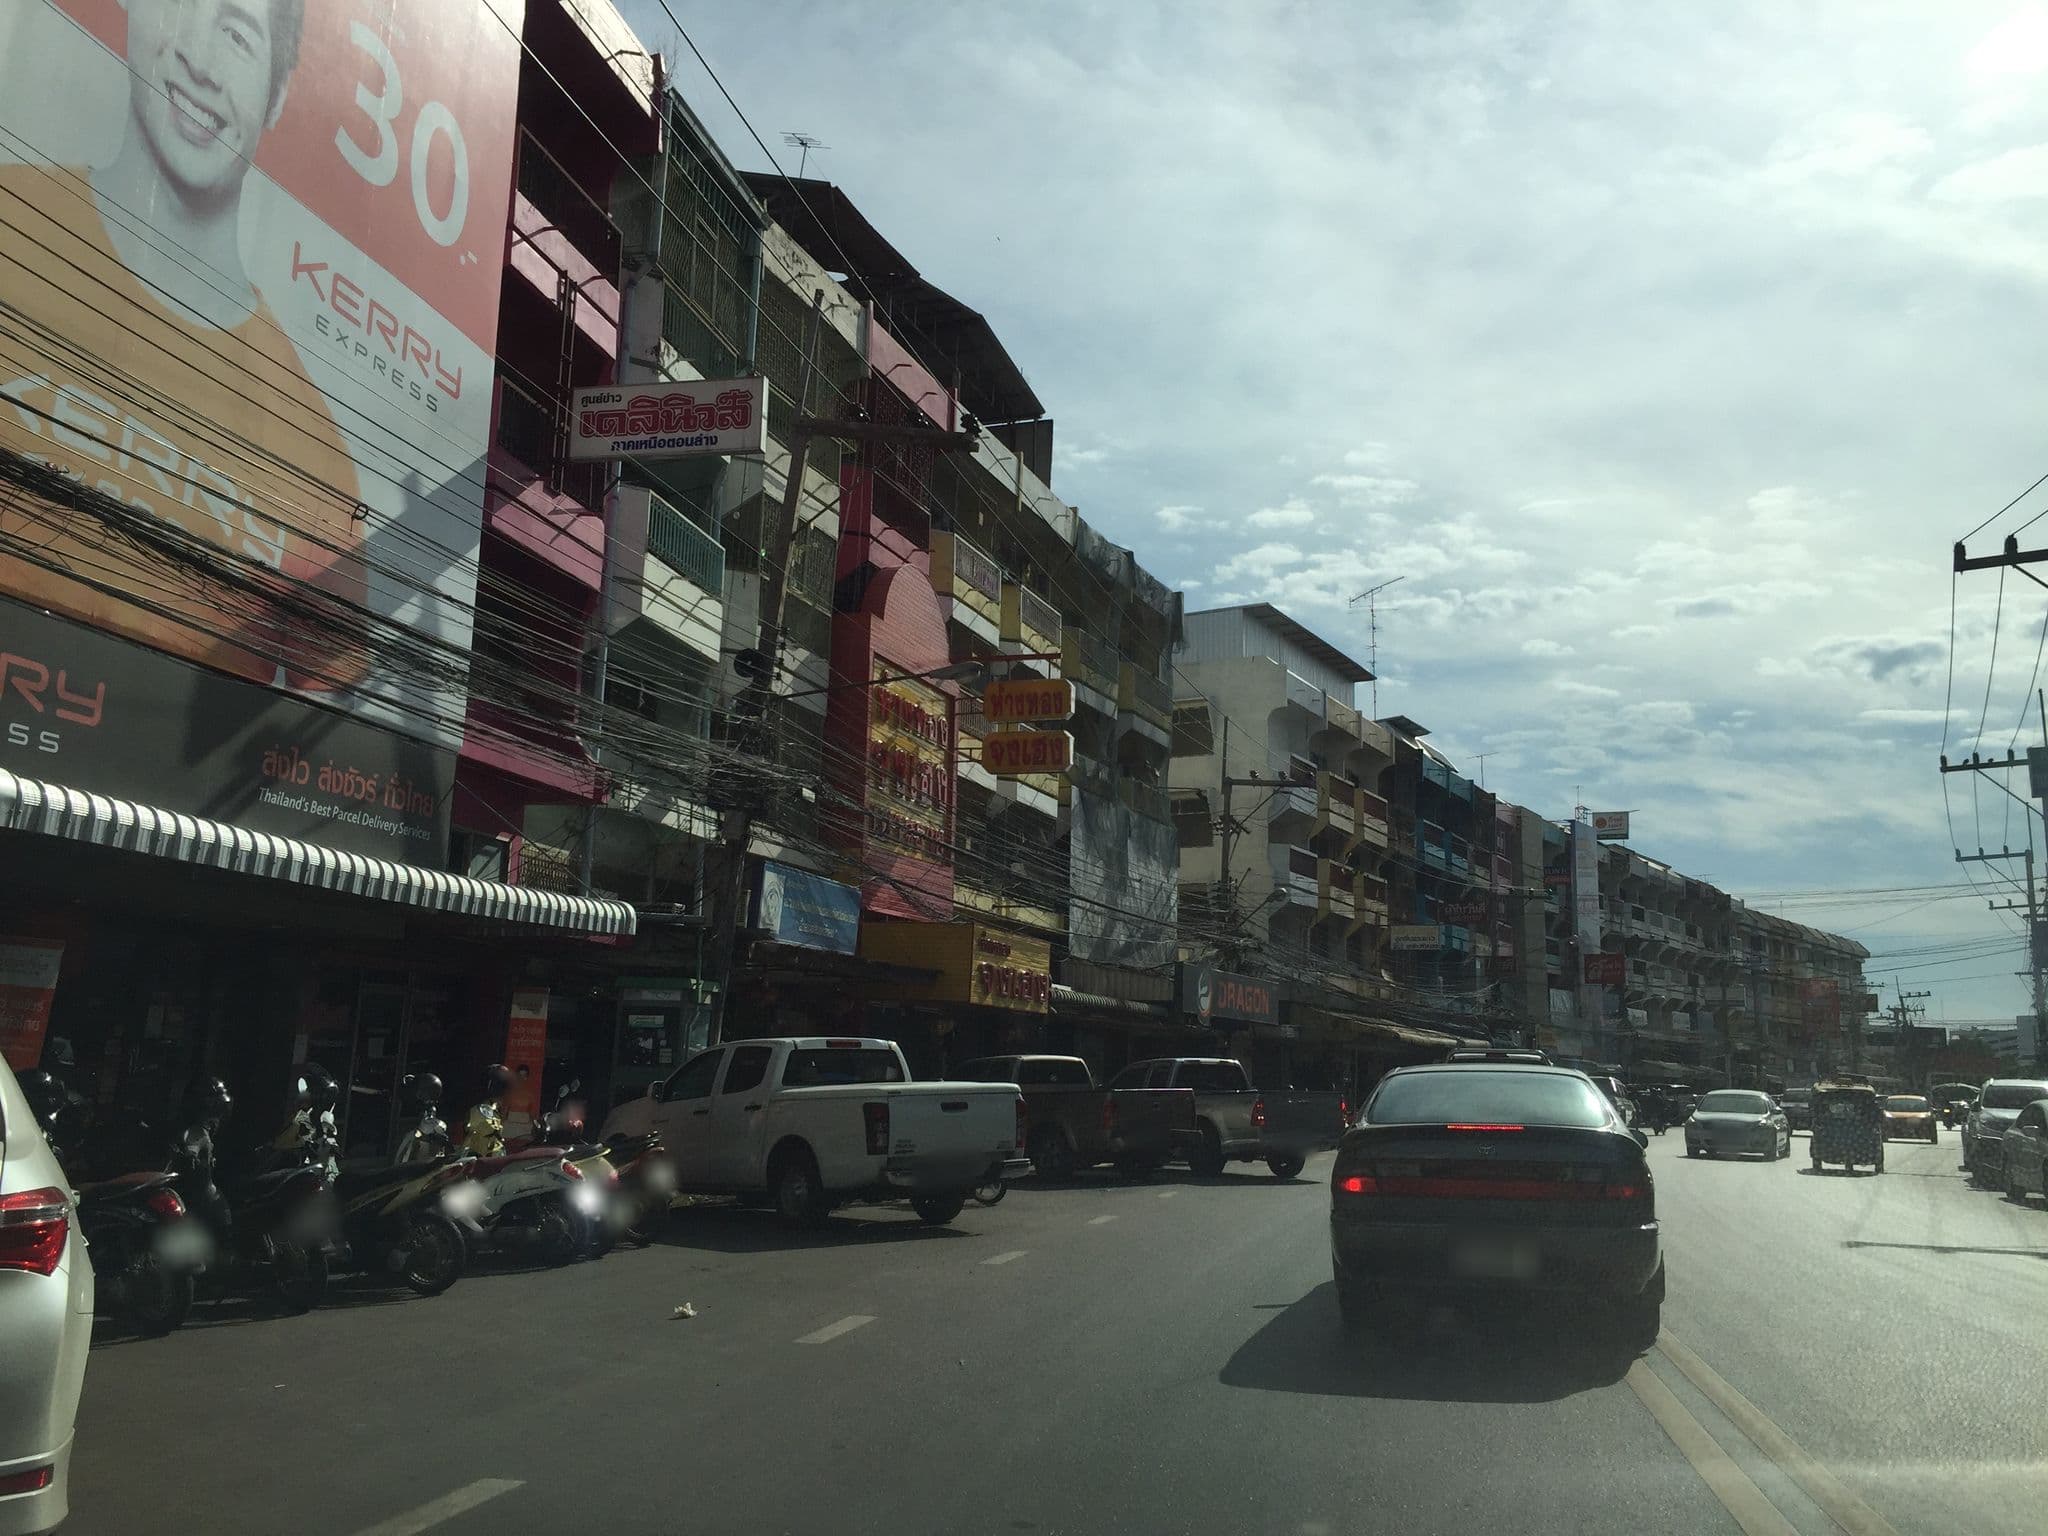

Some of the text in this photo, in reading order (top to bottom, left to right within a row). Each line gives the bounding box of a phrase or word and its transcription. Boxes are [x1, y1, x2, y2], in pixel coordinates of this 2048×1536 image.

[291, 241, 462, 400] KERRY
[315, 314, 439, 413] EXPRESS
[581, 391, 623, 407] ศูนย์ข่าว
[611, 433, 718, 452] ภาคเหนือตอนล่าง
[262, 744, 311, 786] ส่งไว
[258, 786, 433, 841] Thailand's Best Parcel Delivery Services
